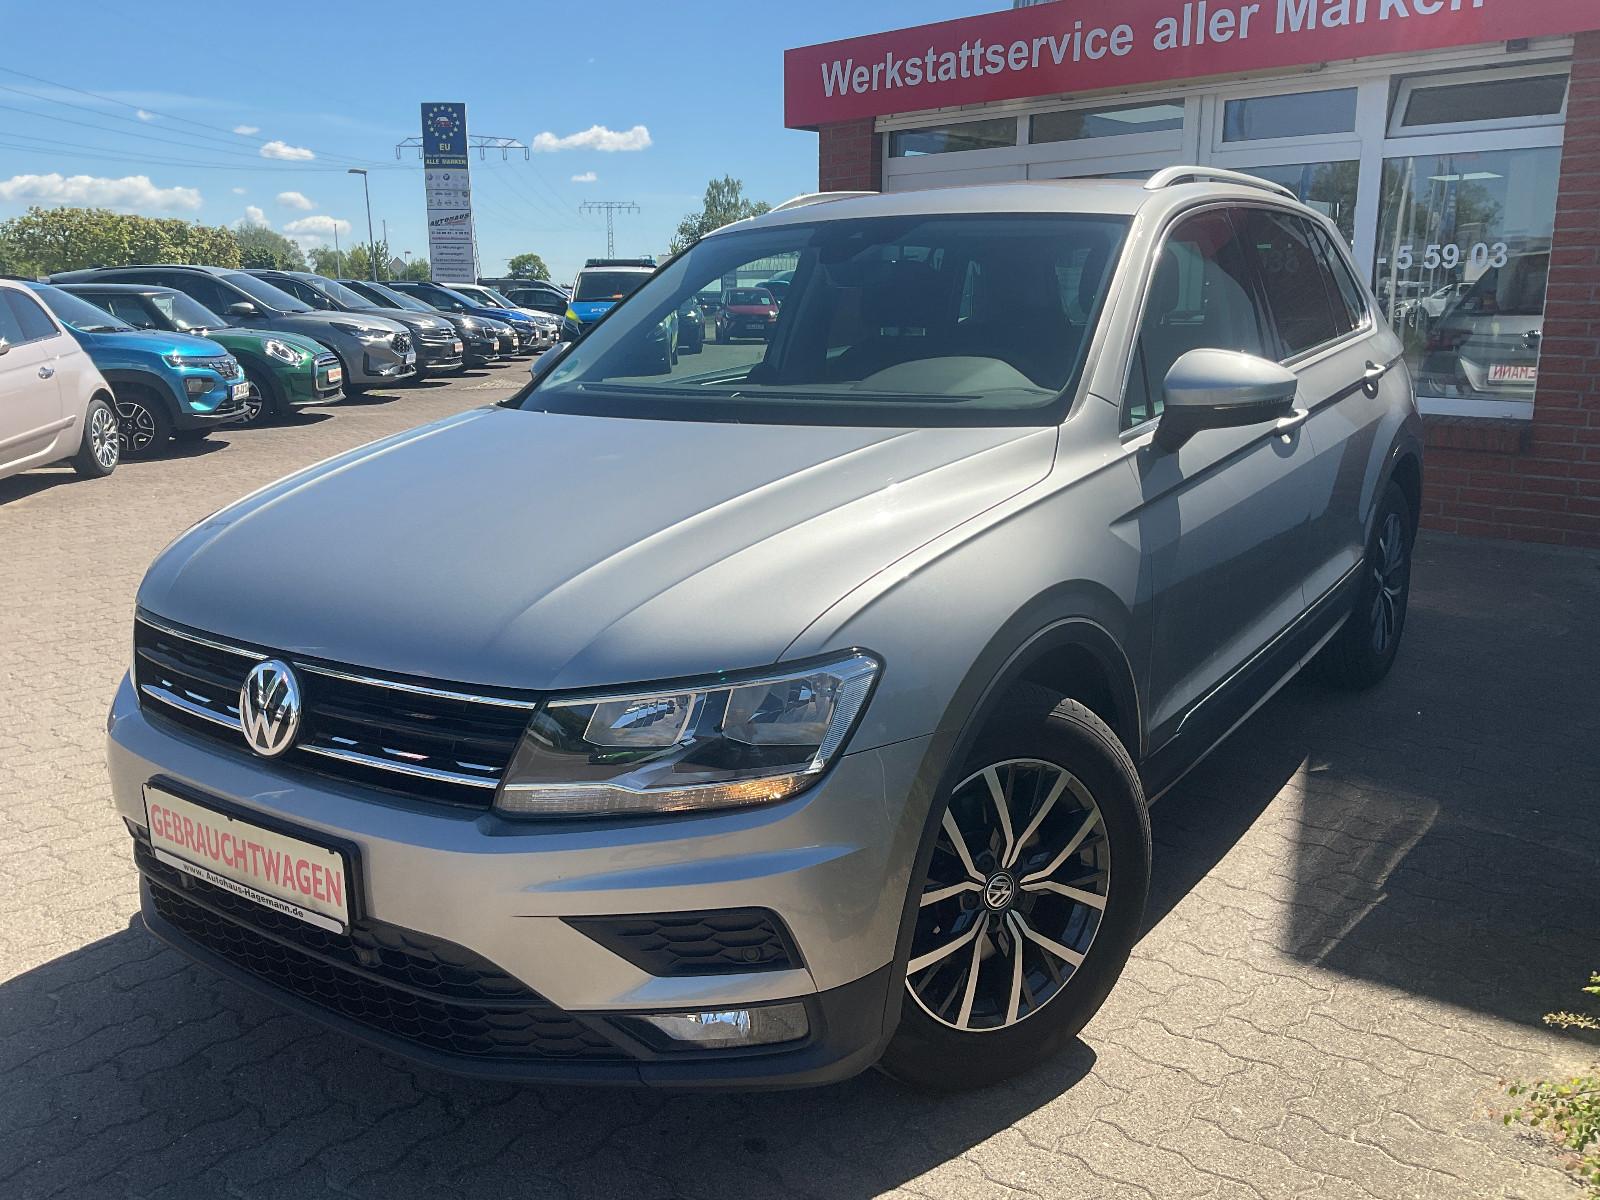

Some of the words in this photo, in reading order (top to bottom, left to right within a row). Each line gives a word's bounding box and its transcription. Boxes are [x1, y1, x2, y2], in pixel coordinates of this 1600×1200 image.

[821, 20, 1134, 98] Werkstattservice
[1153, 1, 1259, 51] aller
[1275, 0, 1483, 34] Mar
[439, 143, 451, 151] EU
[1397, 244, 1413, 270] 5
[1423, 243, 1460, 269] 59
[1470, 242, 1508, 268] 03
[241, 660, 300, 756] VW
[150, 803, 342, 907] GEBRAUCHTWAGEN
[206, 872, 304, 918] Autohaus-Hagemann.de
